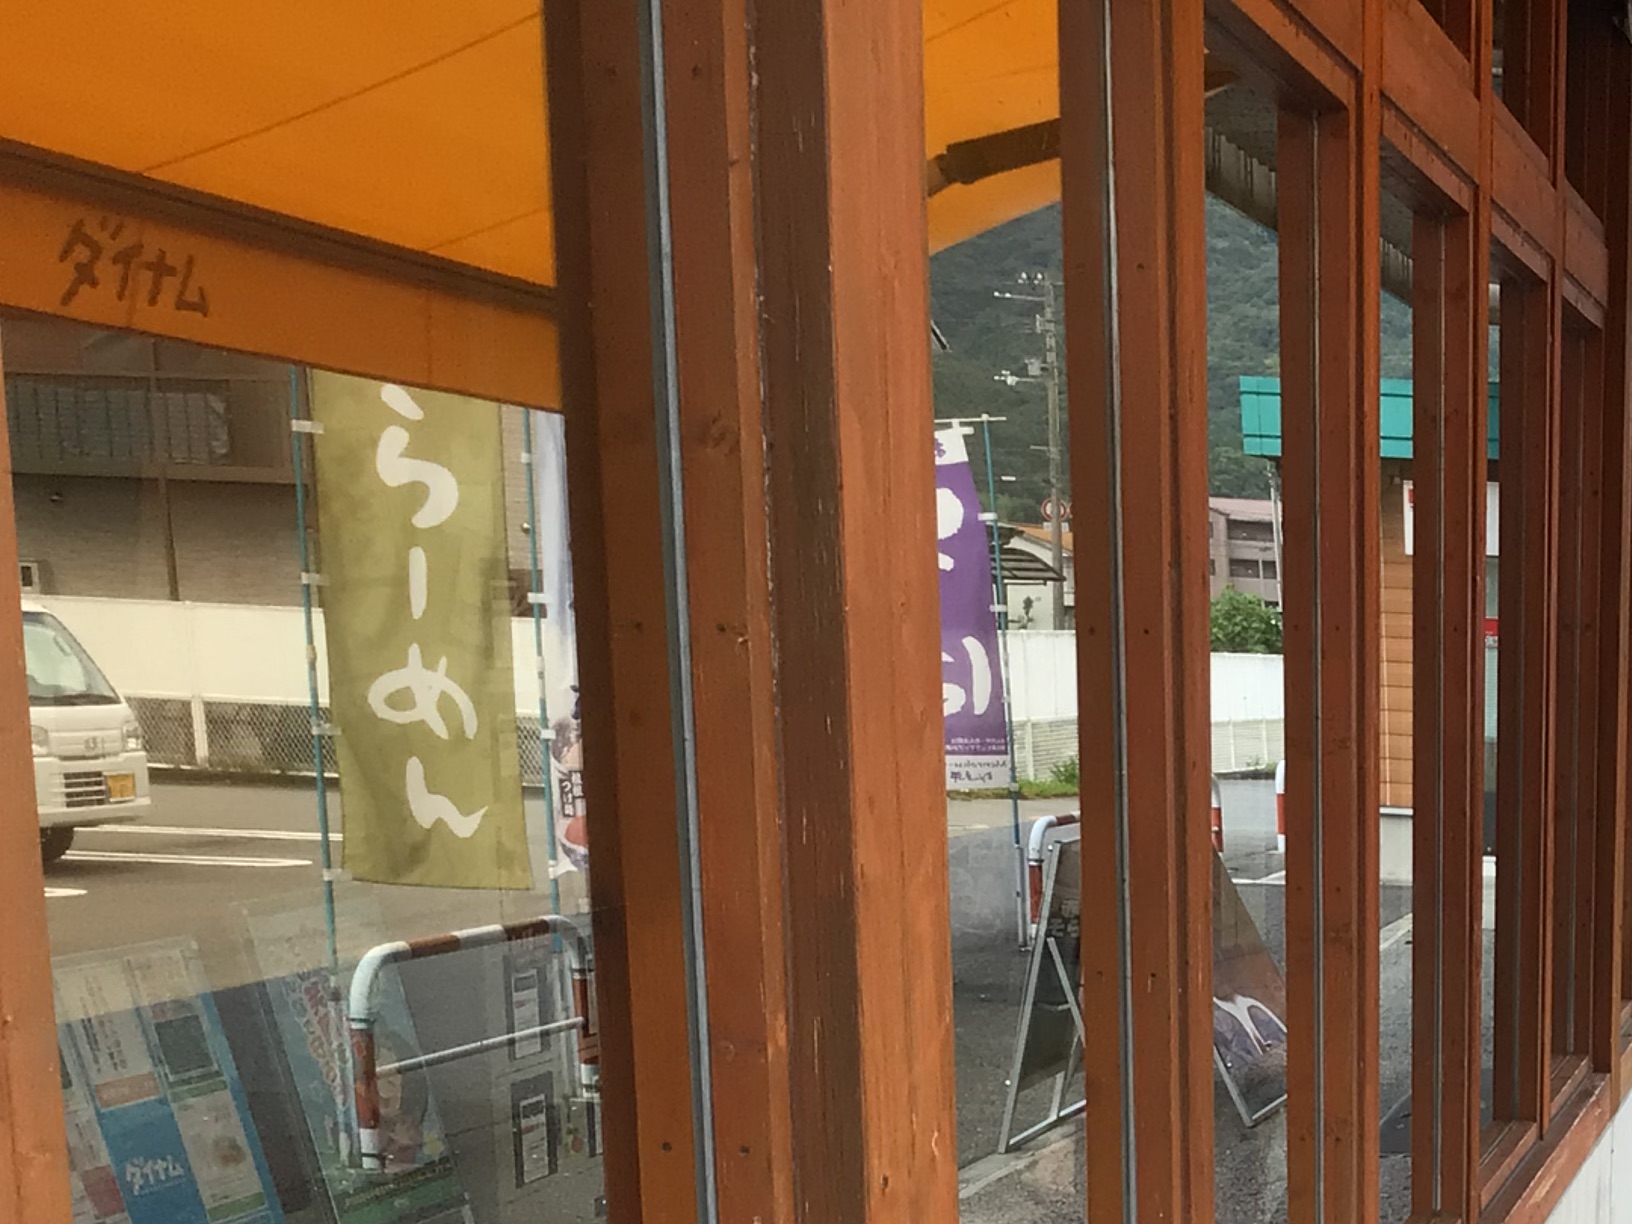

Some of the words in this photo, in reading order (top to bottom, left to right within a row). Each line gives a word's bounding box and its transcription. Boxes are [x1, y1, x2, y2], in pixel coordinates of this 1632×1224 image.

[60, 215, 209, 317] ダイナム
[367, 383, 488, 838] らーめん
